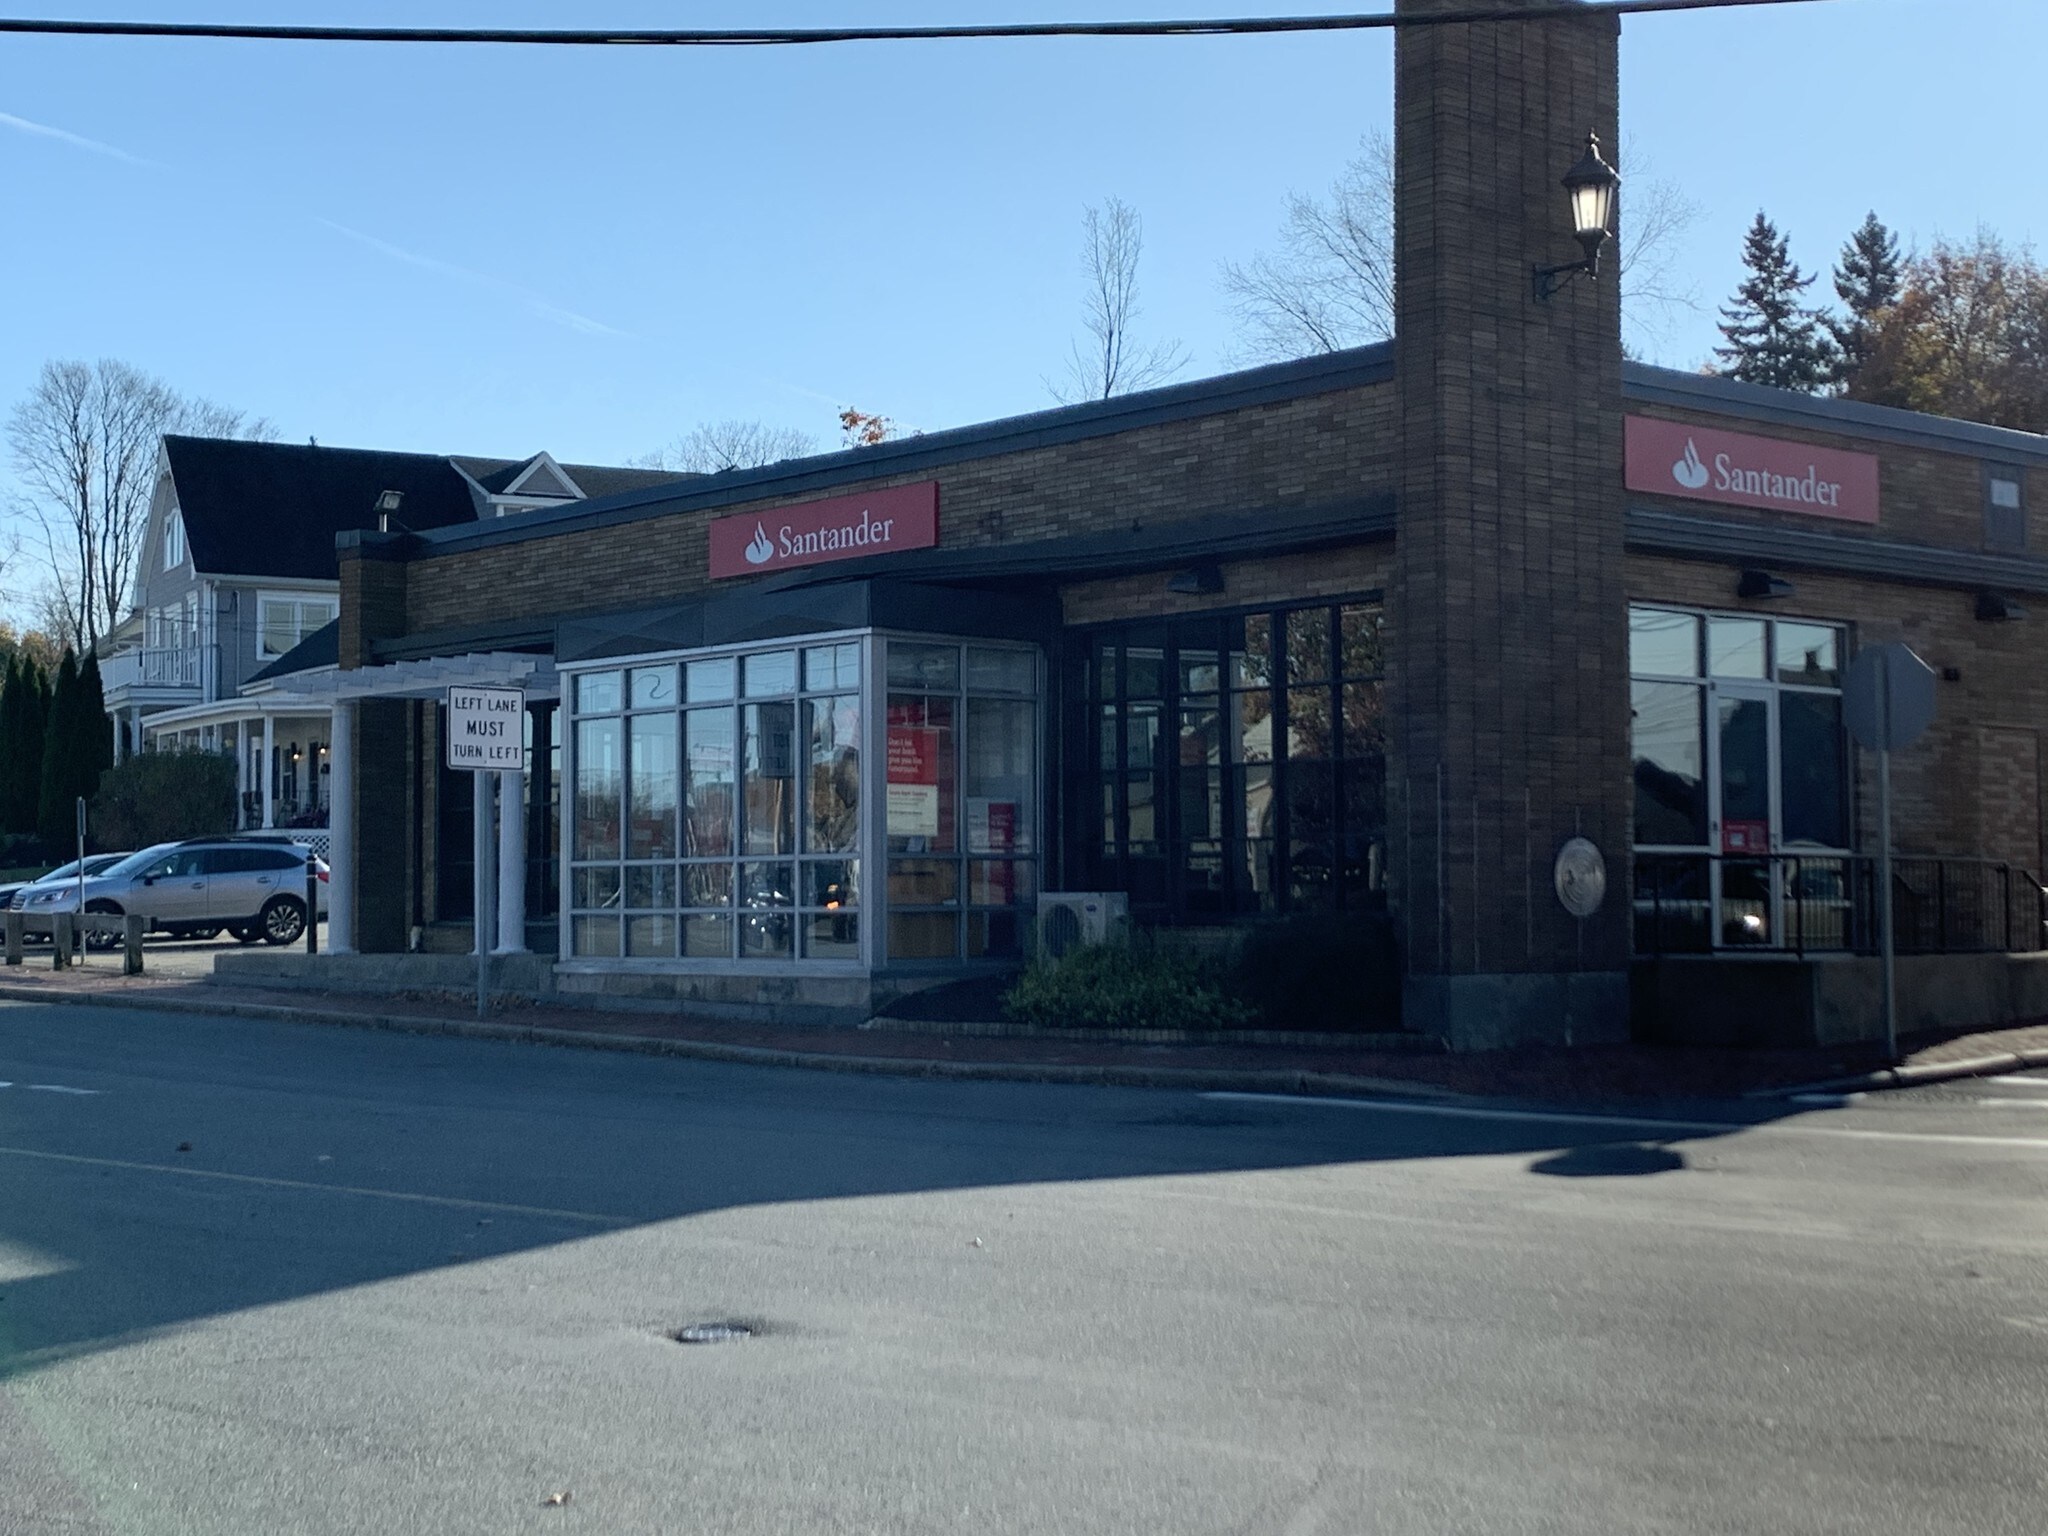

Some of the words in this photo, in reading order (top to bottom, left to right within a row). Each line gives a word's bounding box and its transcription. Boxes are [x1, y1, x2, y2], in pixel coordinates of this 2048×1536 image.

[1714, 453, 1842, 507] Santander
[778, 509, 894, 558] Santander
[455, 697, 483, 710] LEFT
[488, 698, 517, 713] LANE
[466, 720, 505, 736] MUST
[453, 744, 482, 758] TURN
[489, 746, 519, 760] LEFT
